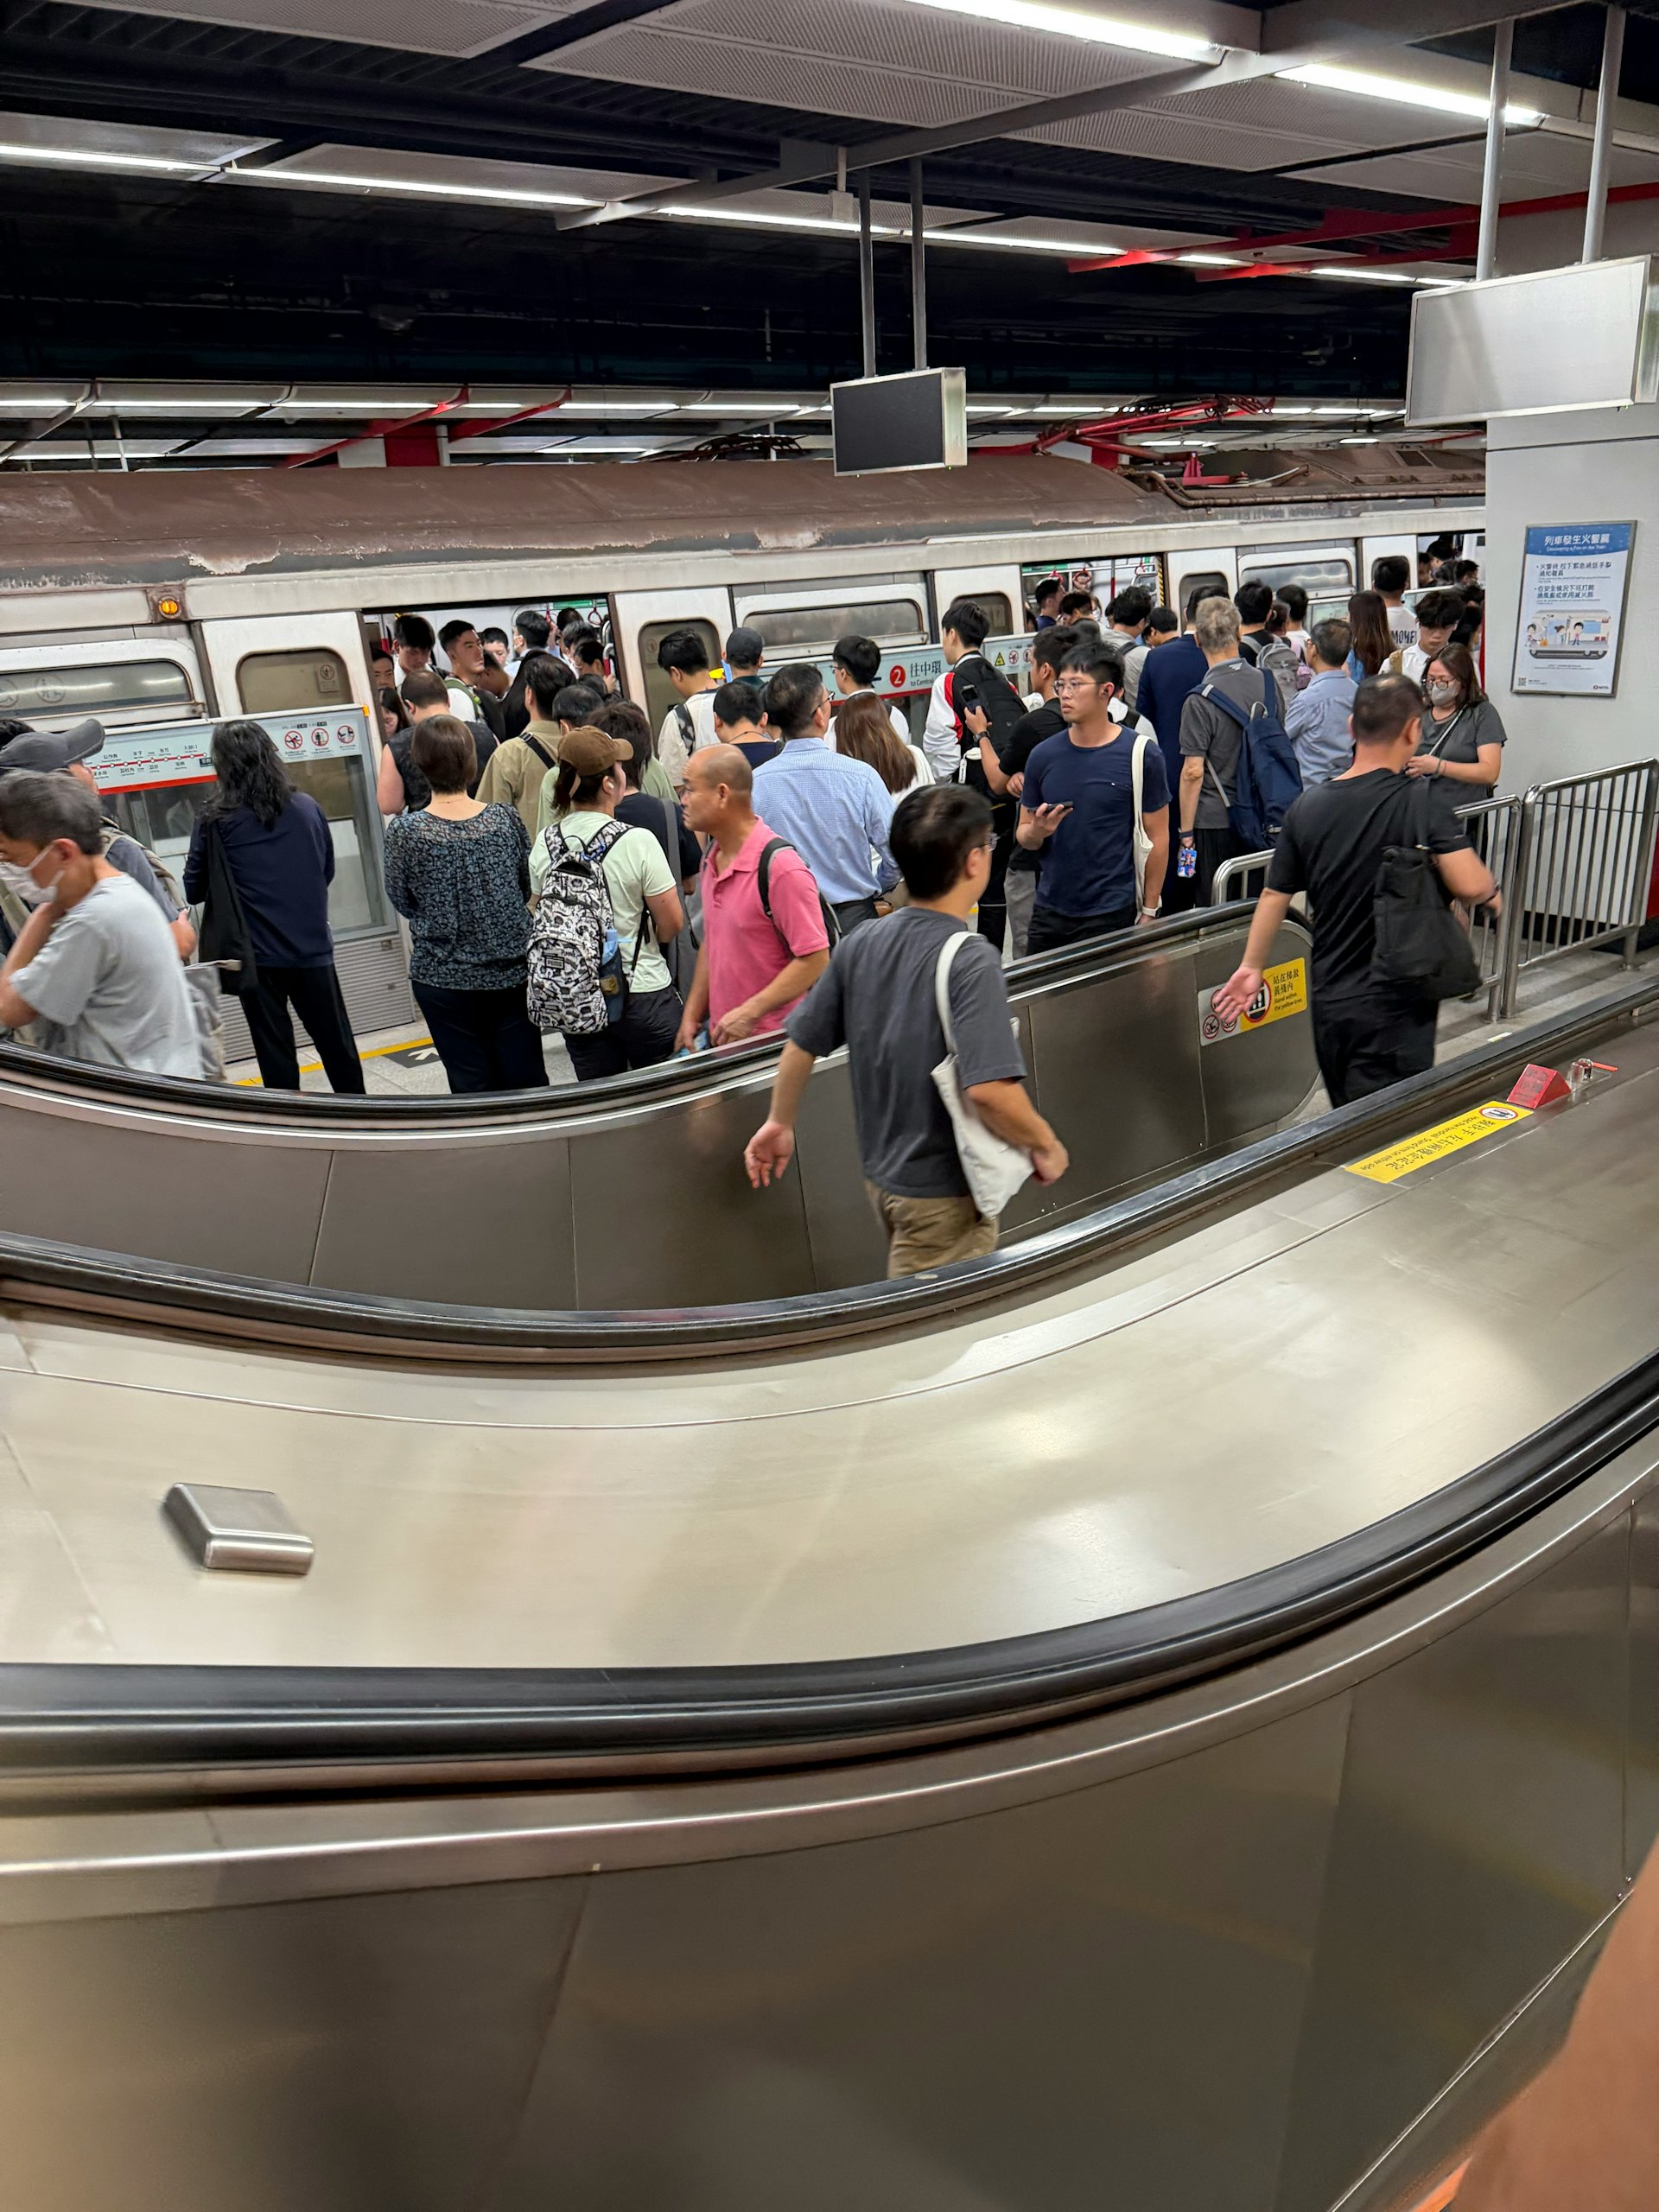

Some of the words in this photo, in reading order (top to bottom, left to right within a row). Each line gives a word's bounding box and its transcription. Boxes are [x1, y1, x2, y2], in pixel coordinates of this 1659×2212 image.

[893, 669, 902, 684] 2
[910, 660, 942, 678] 往中環
